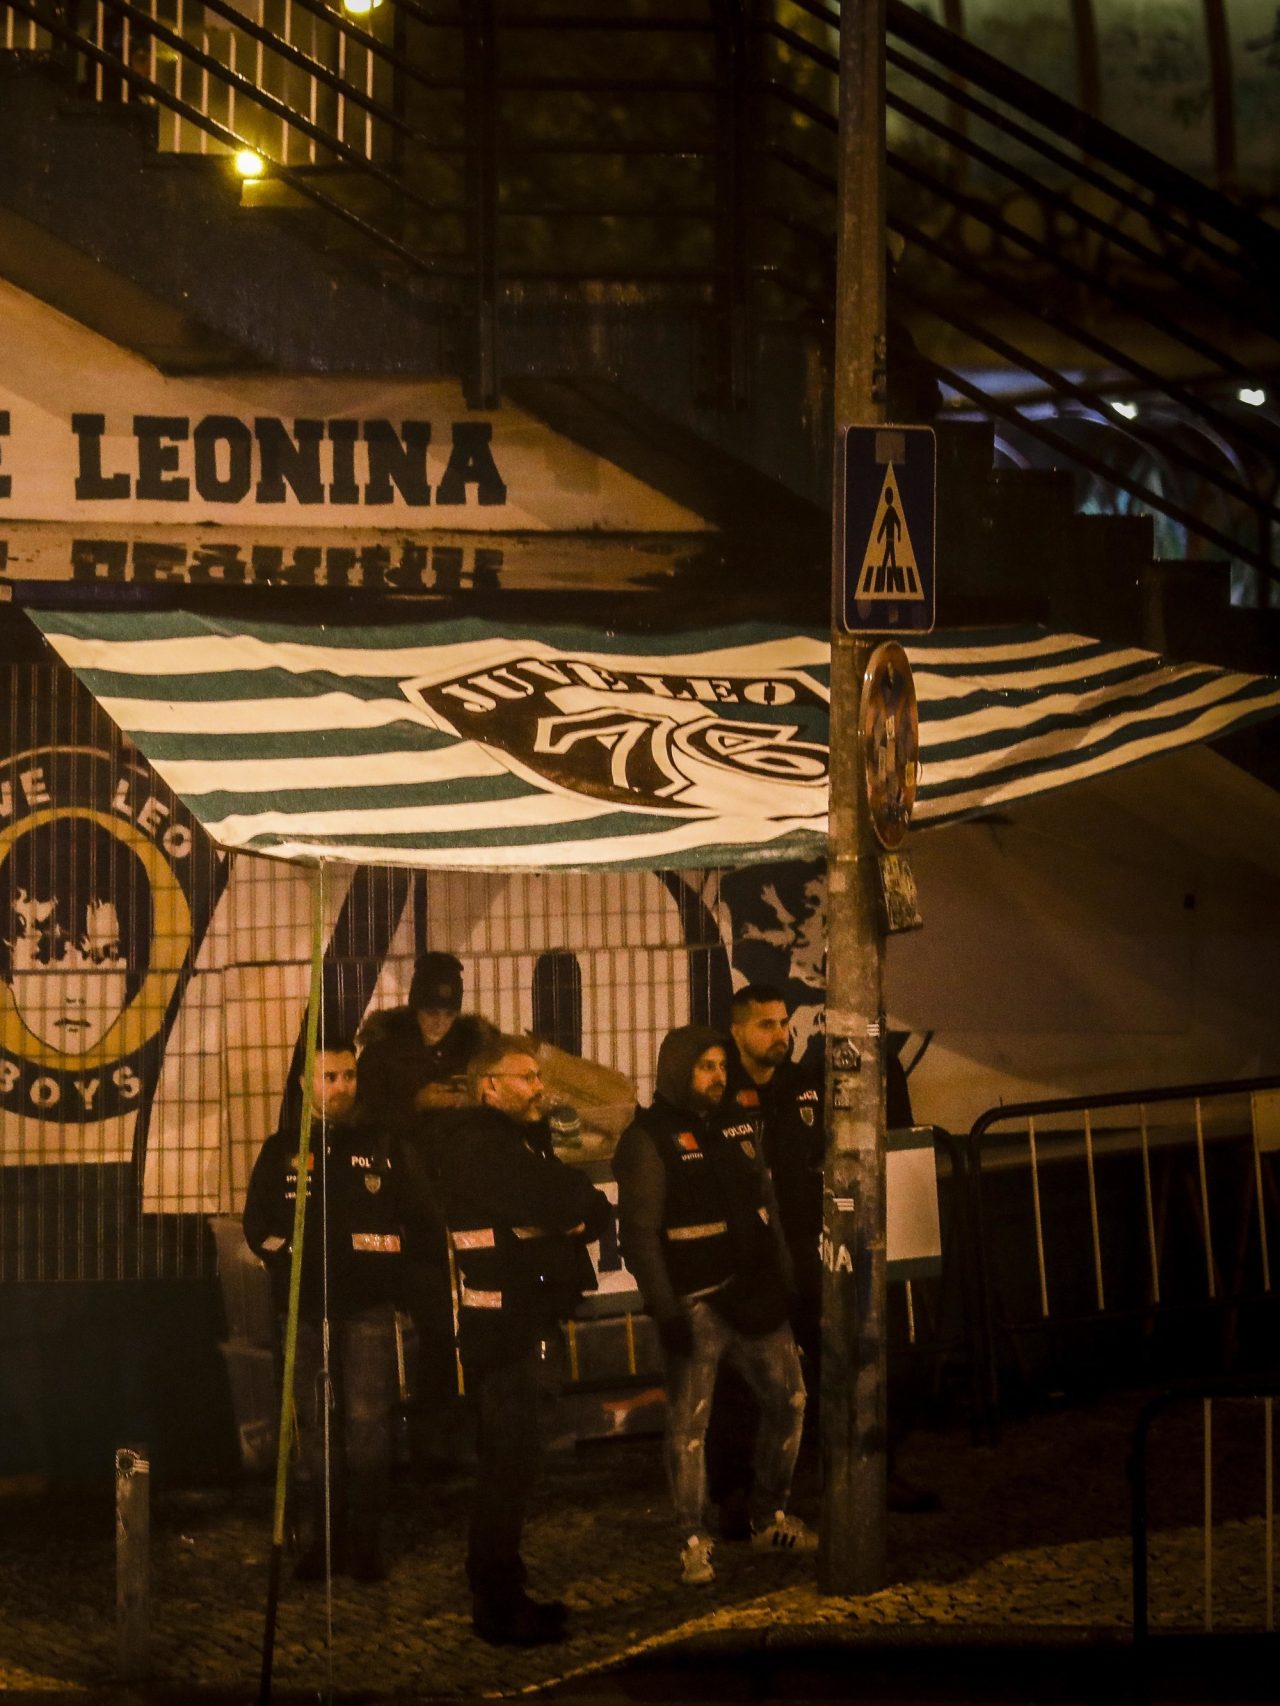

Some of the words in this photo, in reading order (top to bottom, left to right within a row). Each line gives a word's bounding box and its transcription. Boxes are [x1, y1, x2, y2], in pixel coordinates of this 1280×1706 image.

[71, 413, 507, 506] LEONINA
[441, 660, 628, 713] JUVE
[637, 675, 796, 706] LEO
[112, 778, 192, 859] LEO
